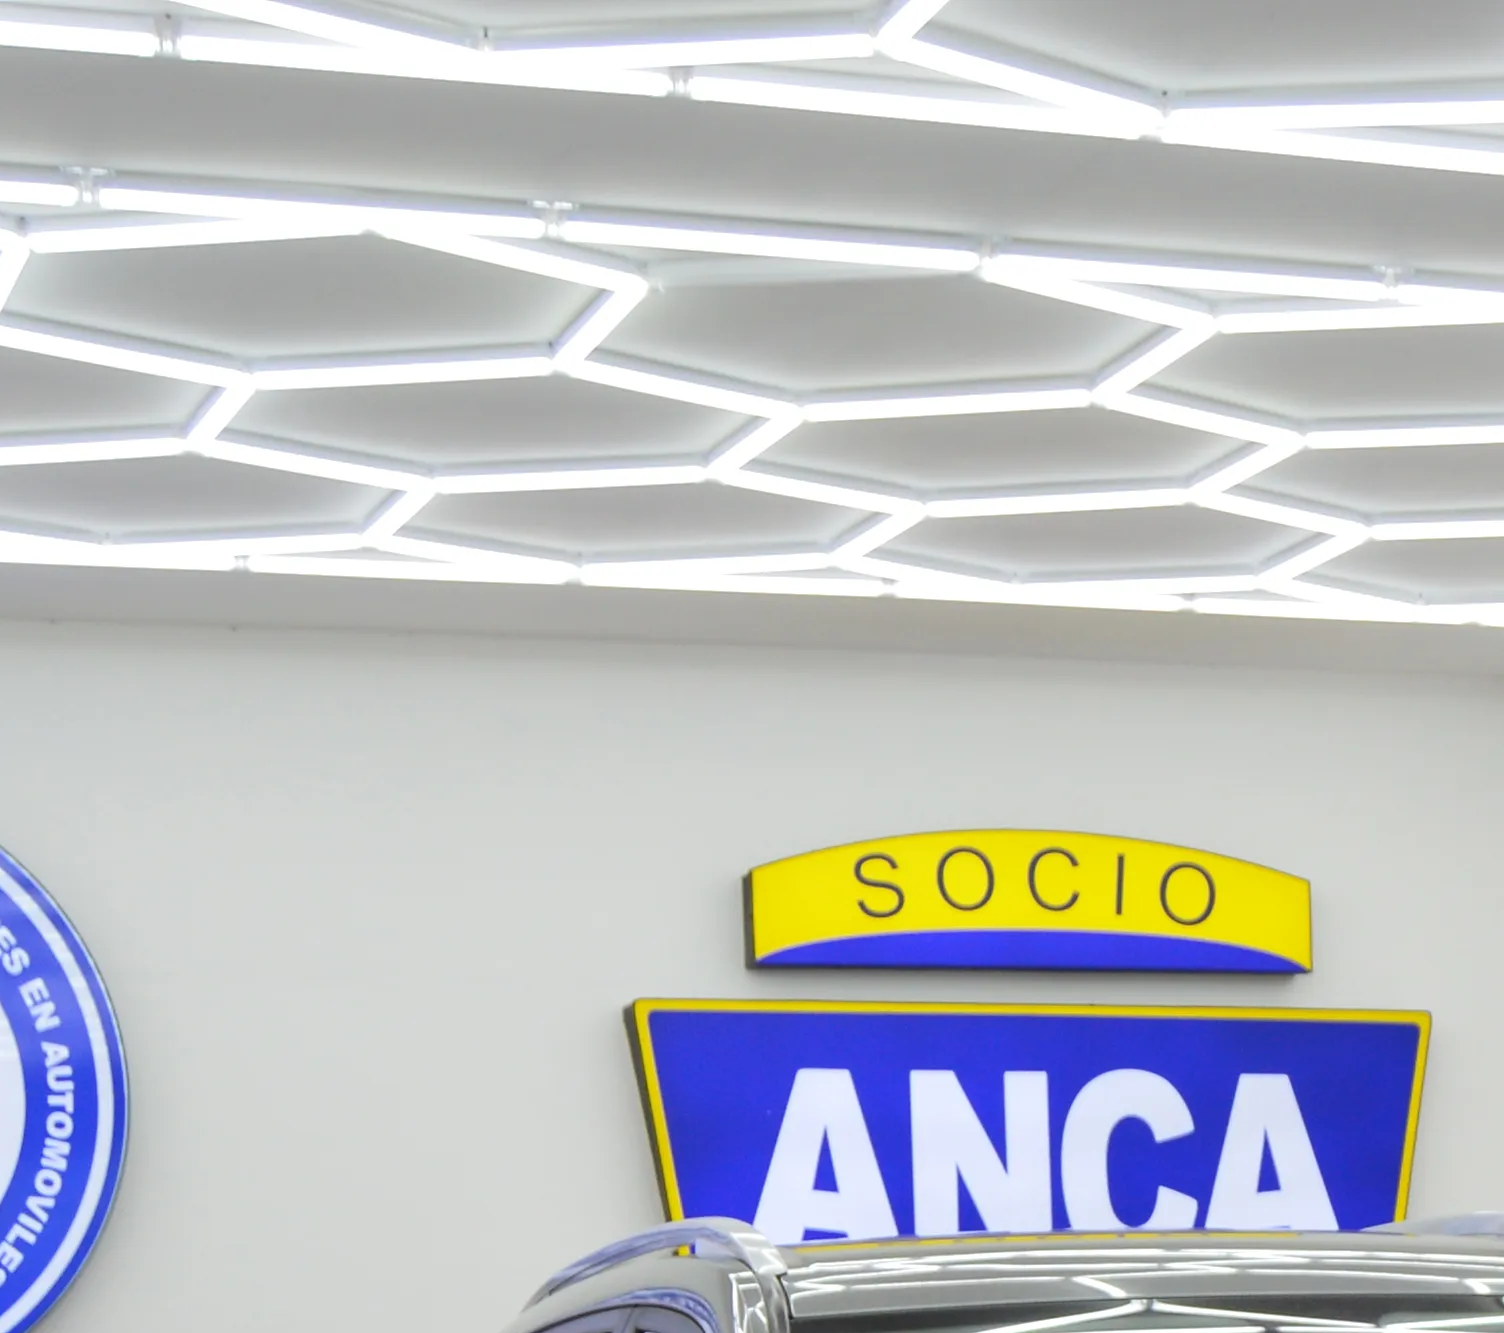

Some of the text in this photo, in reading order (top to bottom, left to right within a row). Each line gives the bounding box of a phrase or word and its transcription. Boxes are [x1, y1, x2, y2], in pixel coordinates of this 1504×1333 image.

[853, 846, 1217, 926] SOCIO
[19, 977, 62, 1032] EN
[751, 1067, 1339, 1241] ANCA
